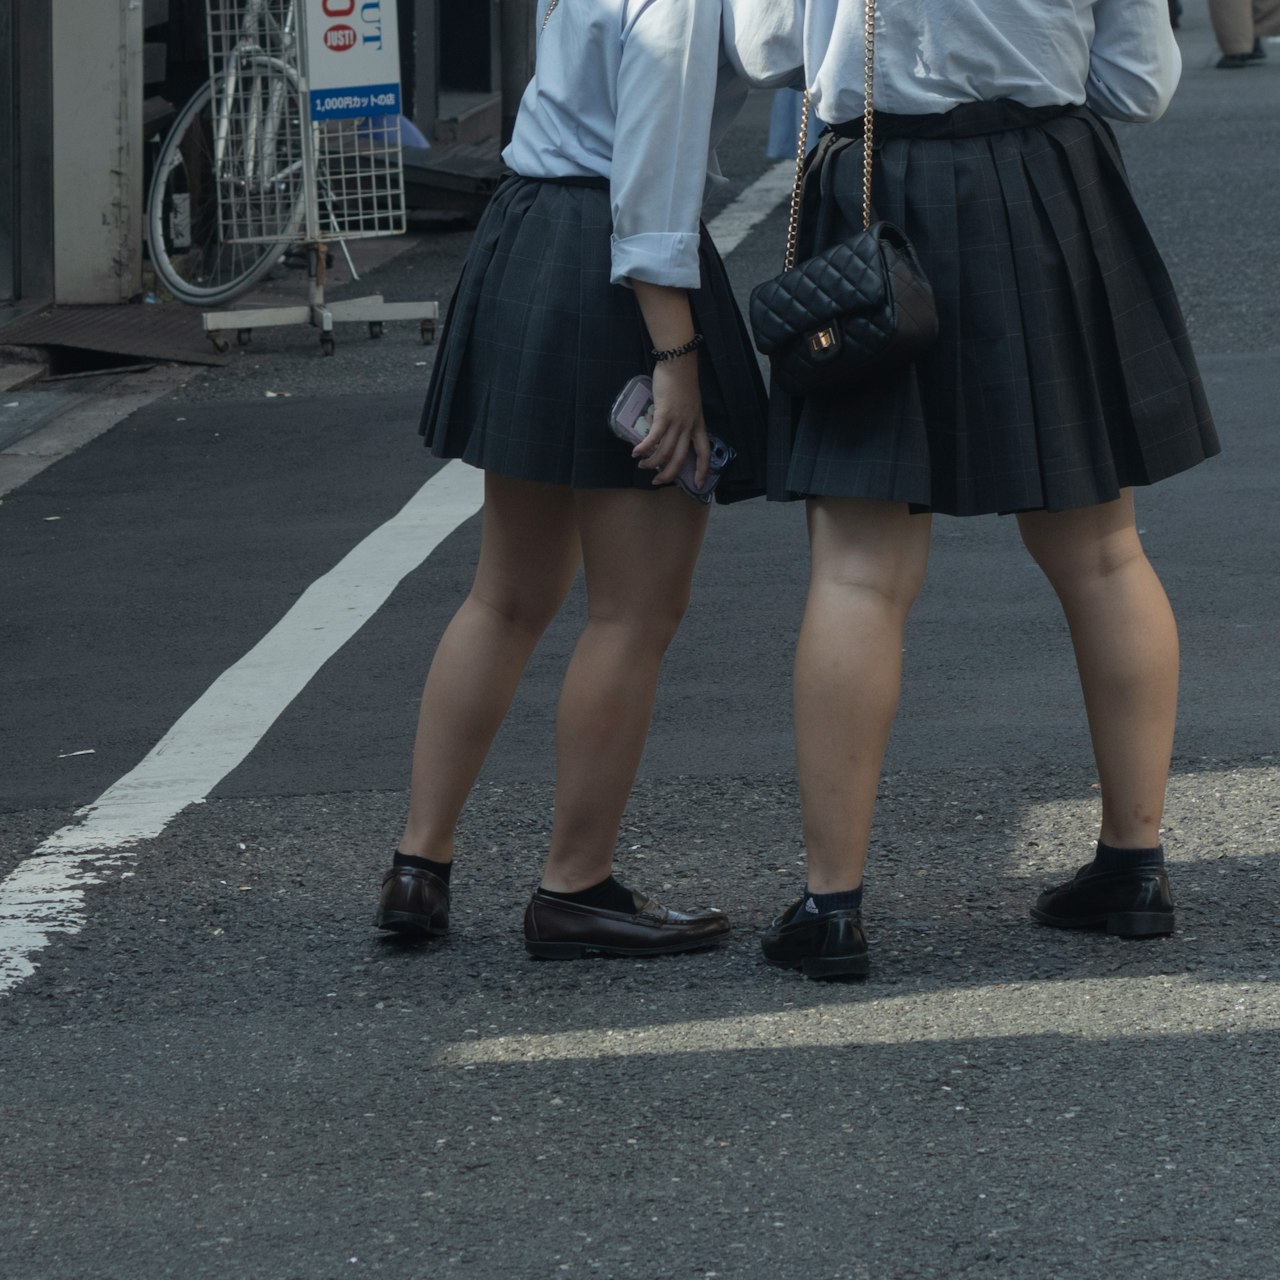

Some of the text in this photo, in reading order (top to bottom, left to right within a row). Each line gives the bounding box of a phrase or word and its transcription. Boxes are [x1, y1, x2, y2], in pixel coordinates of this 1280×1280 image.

[325, 29, 354, 48] JUST!
[315, 93, 396, 113] 1,000円カットの店
